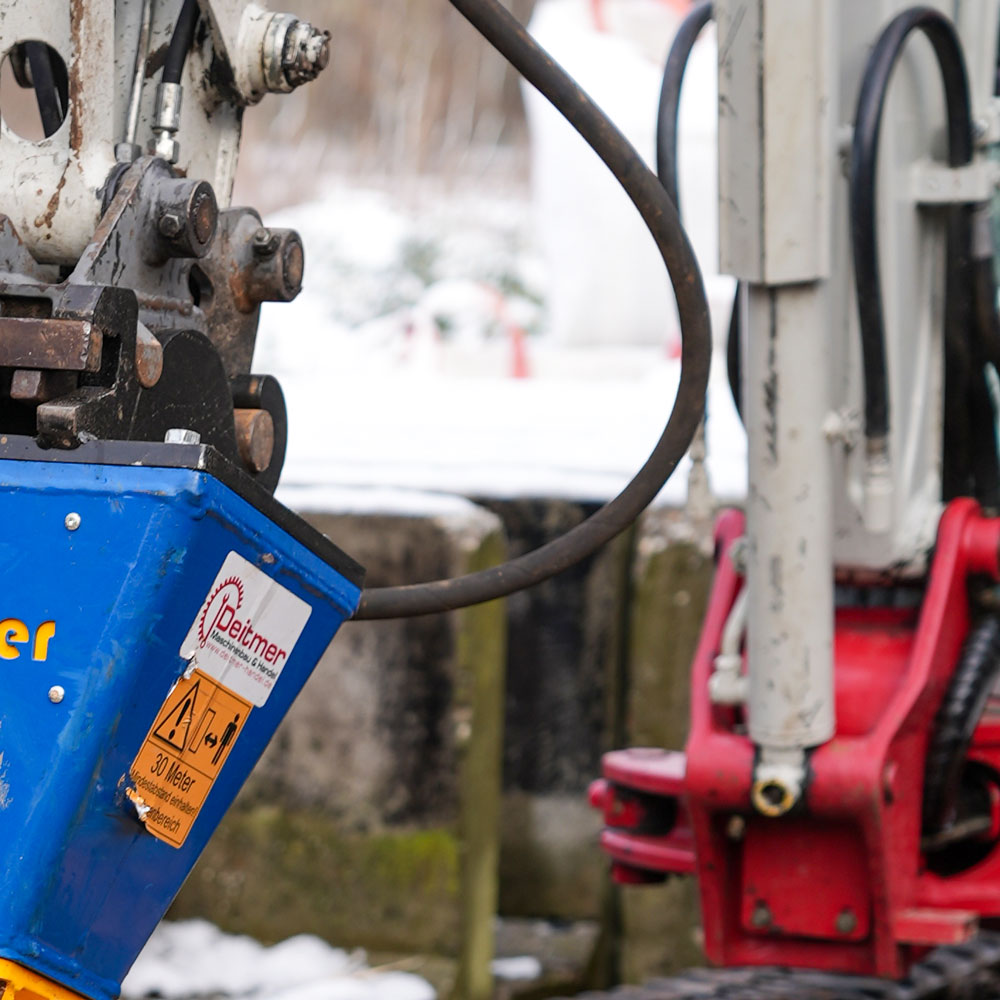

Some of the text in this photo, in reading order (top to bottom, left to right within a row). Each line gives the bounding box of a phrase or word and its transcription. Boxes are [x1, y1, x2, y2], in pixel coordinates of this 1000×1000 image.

[210, 629, 279, 680] Maschinenbau & Handel
[216, 604, 287, 666] Deitmer
[150, 752, 197, 793] 30 Meter
